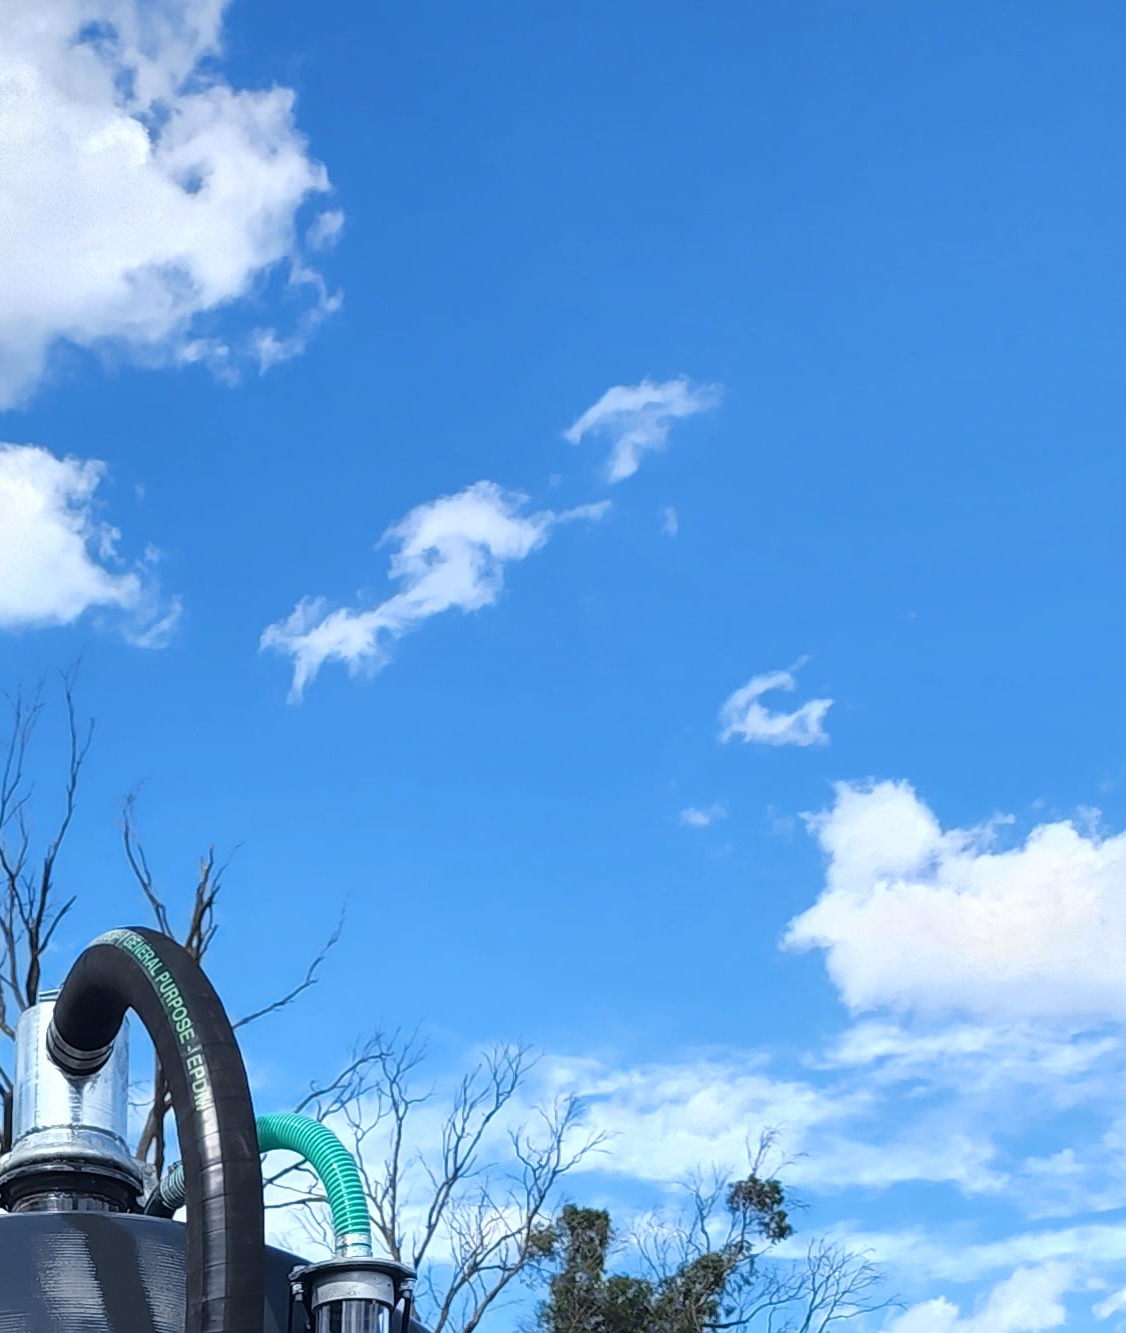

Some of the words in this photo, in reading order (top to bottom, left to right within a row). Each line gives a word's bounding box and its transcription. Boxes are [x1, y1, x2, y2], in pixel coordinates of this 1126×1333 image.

[125, 933, 161, 977] GENERAL
[155, 970, 195, 1044] PURPOSE
[185, 1053, 212, 1112] EPDM
